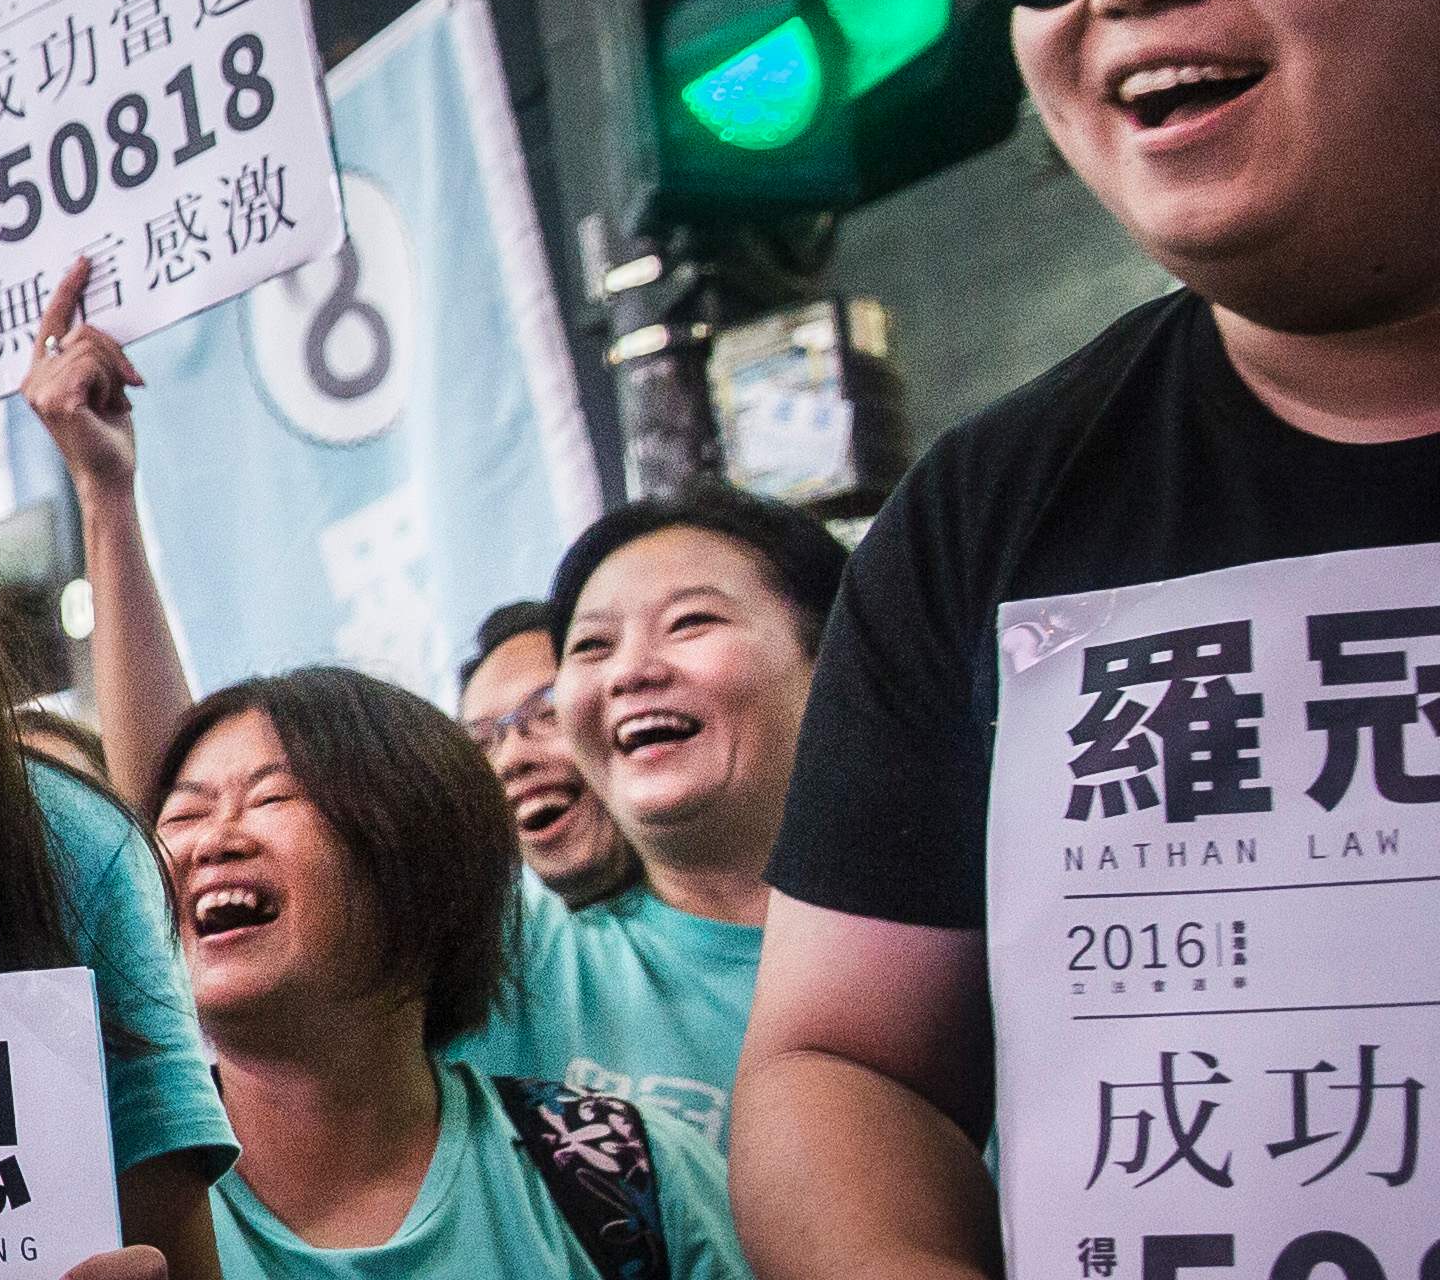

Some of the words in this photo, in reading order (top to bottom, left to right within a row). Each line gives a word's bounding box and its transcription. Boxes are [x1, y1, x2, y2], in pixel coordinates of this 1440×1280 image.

[1065, 838, 1257, 870] NATHAN
[1309, 828, 1403, 860] LAW
[1067, 922, 1206, 971] 2016
[1085, 1043, 1423, 1193] 成功
